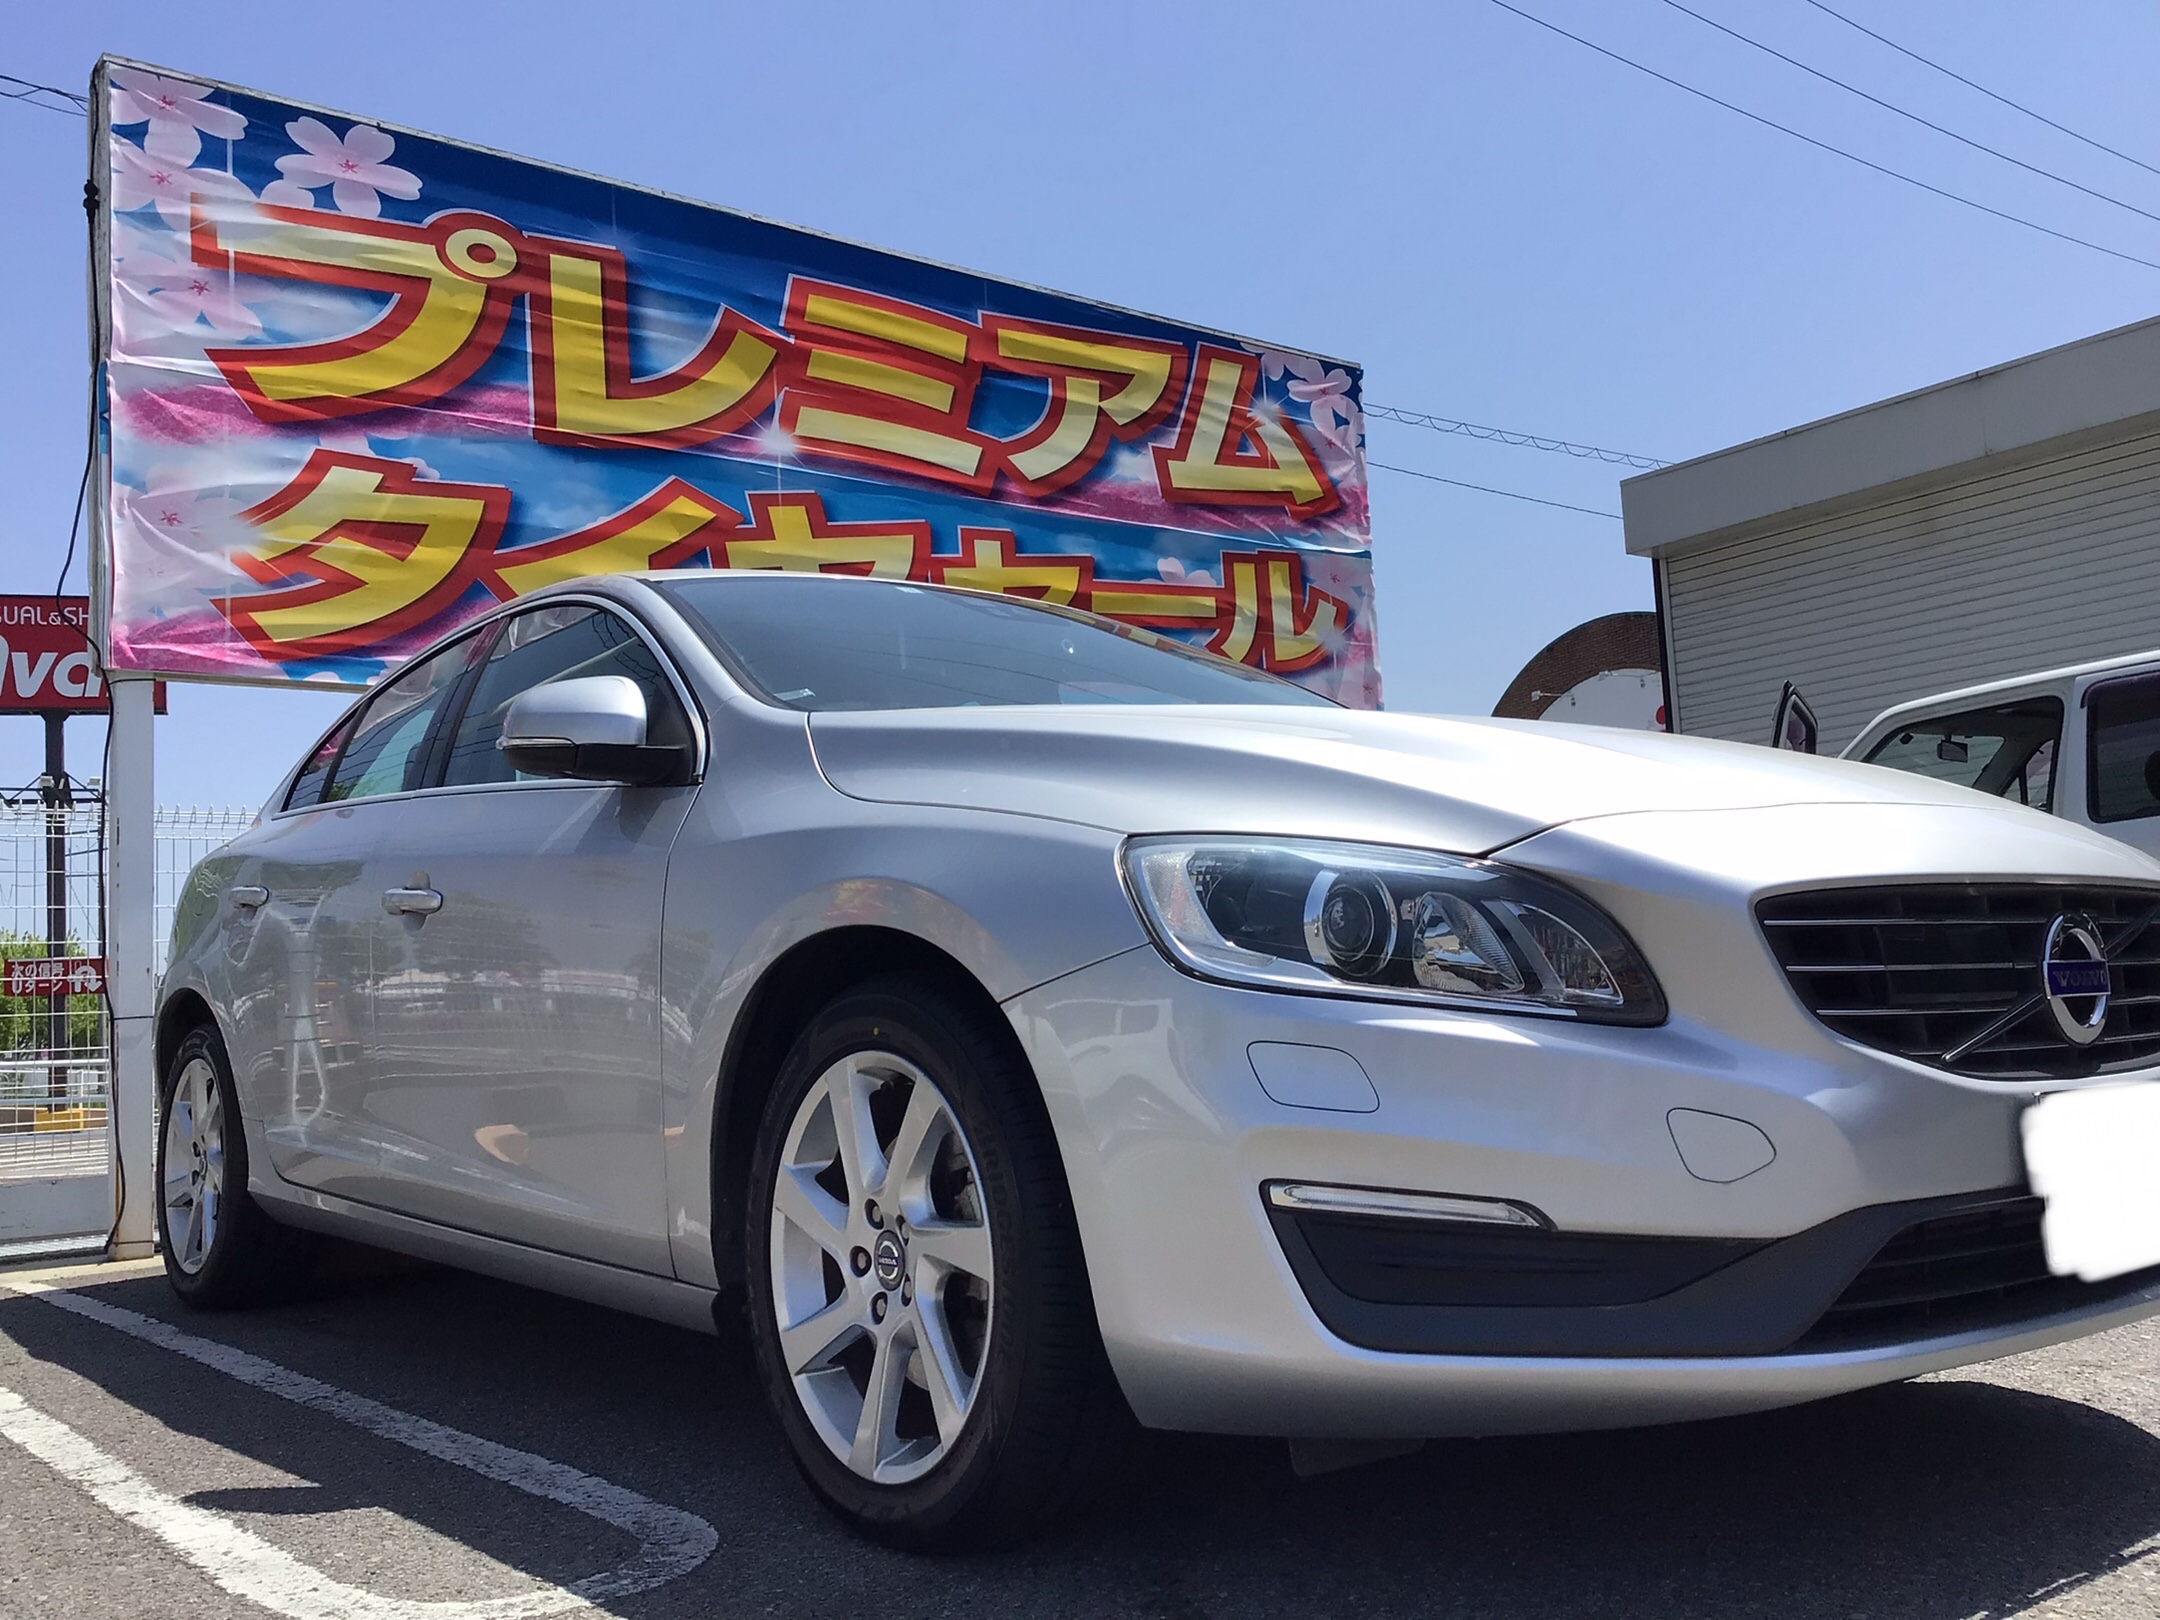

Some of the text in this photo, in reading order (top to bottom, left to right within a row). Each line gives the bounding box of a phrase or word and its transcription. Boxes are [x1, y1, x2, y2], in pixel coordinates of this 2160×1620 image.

[190, 190, 1341, 520] プレミアム
[0, 605, 89, 626] UAL&SH
[0, 634, 110, 699] va
[11, 962, 64, 979] 次の信号
[2052, 969, 2108, 988] VOLVO
